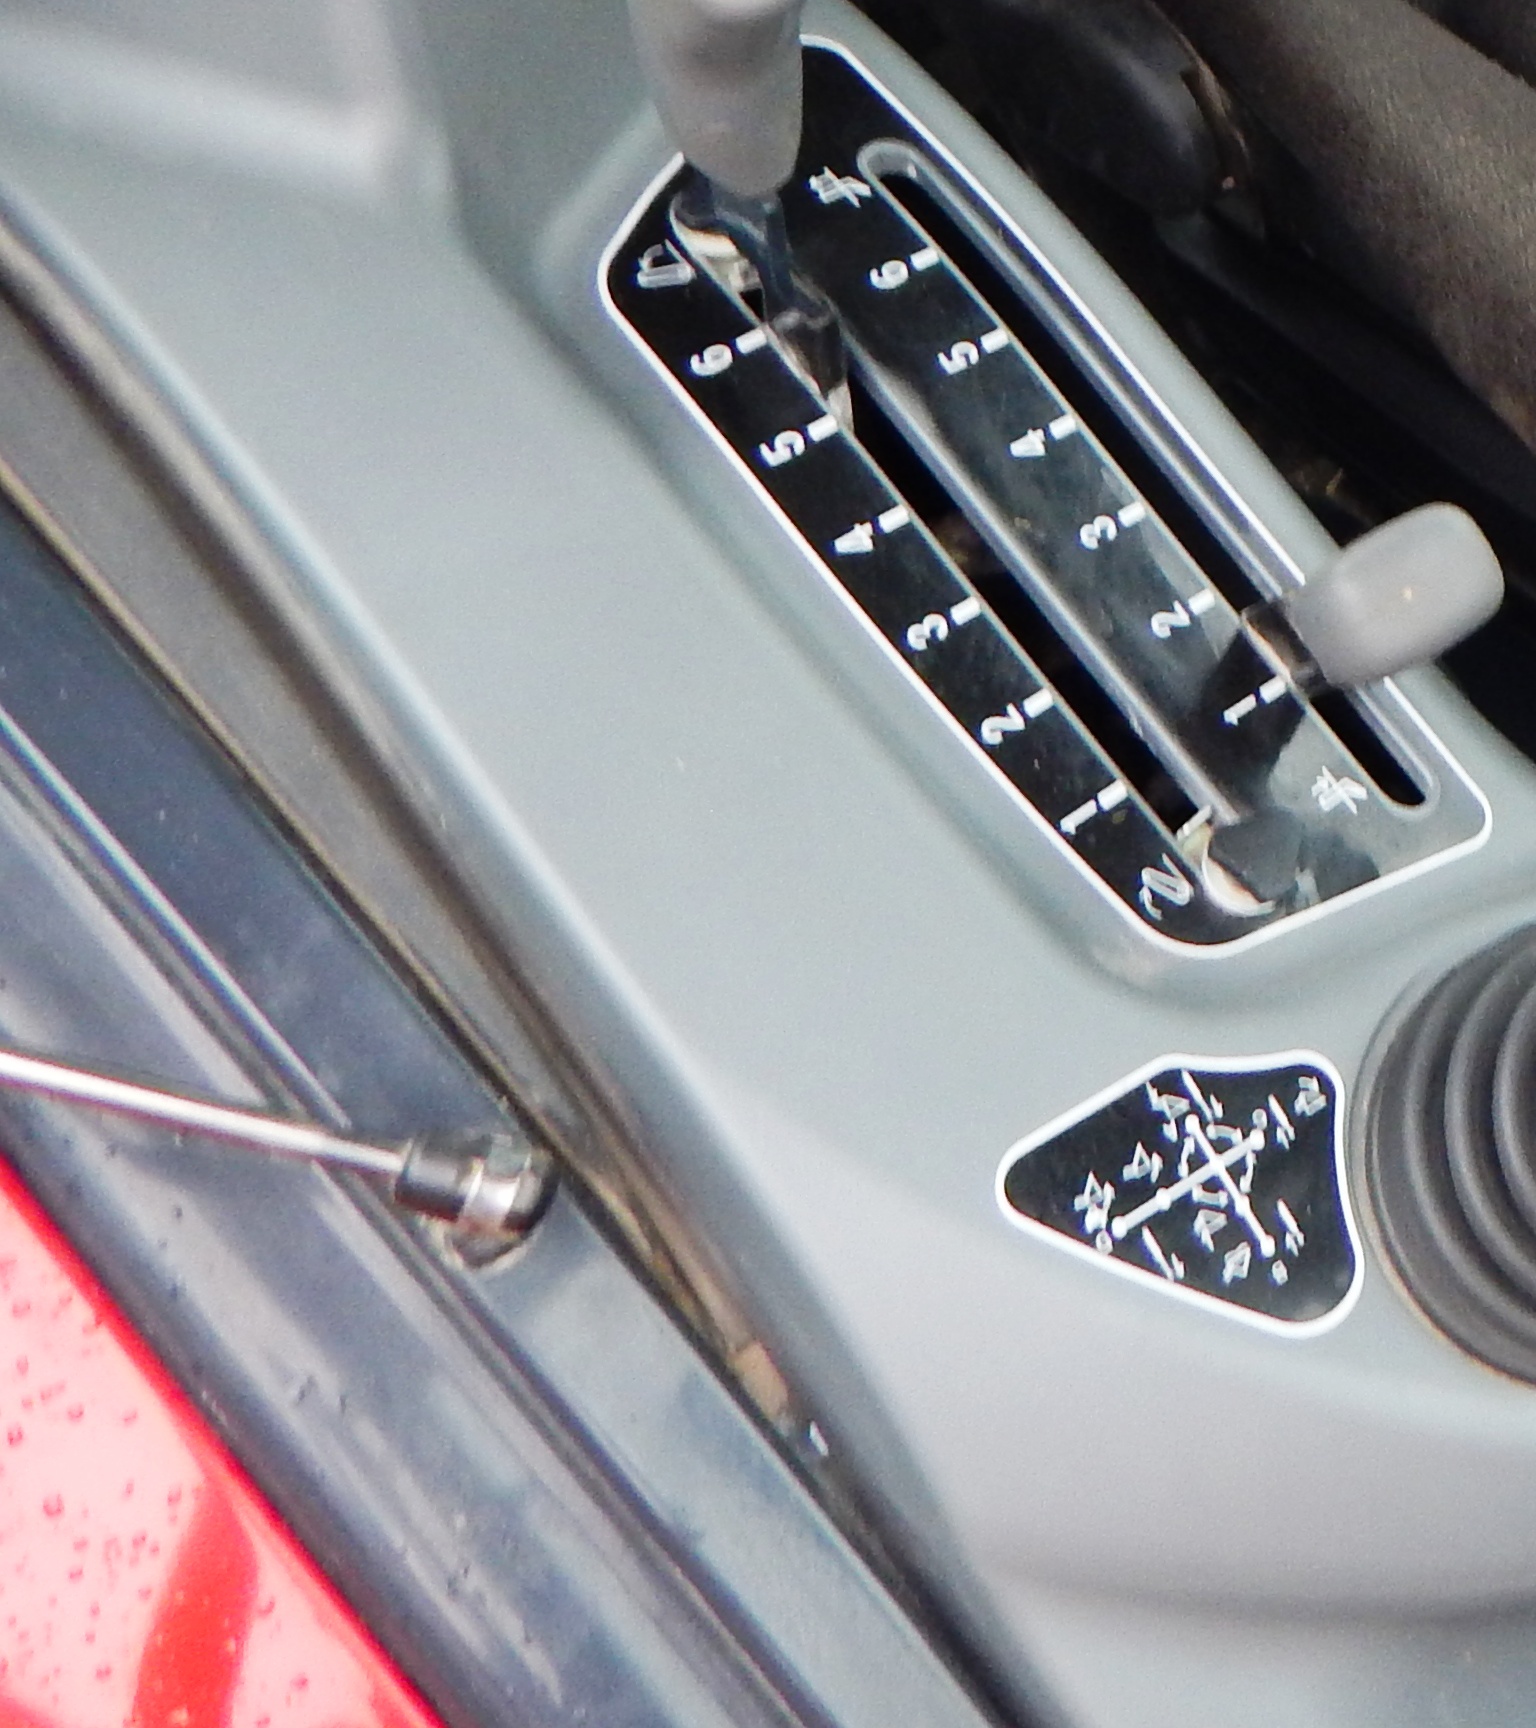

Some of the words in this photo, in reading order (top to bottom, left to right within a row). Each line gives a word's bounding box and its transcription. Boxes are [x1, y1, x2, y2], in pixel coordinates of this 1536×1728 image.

[937, 341, 980, 375] 5
[759, 430, 806, 467] 5
[1079, 515, 1118, 550] 3
[906, 613, 949, 651] 3
[1150, 600, 1191, 639] 2
[980, 703, 1026, 745] 2
